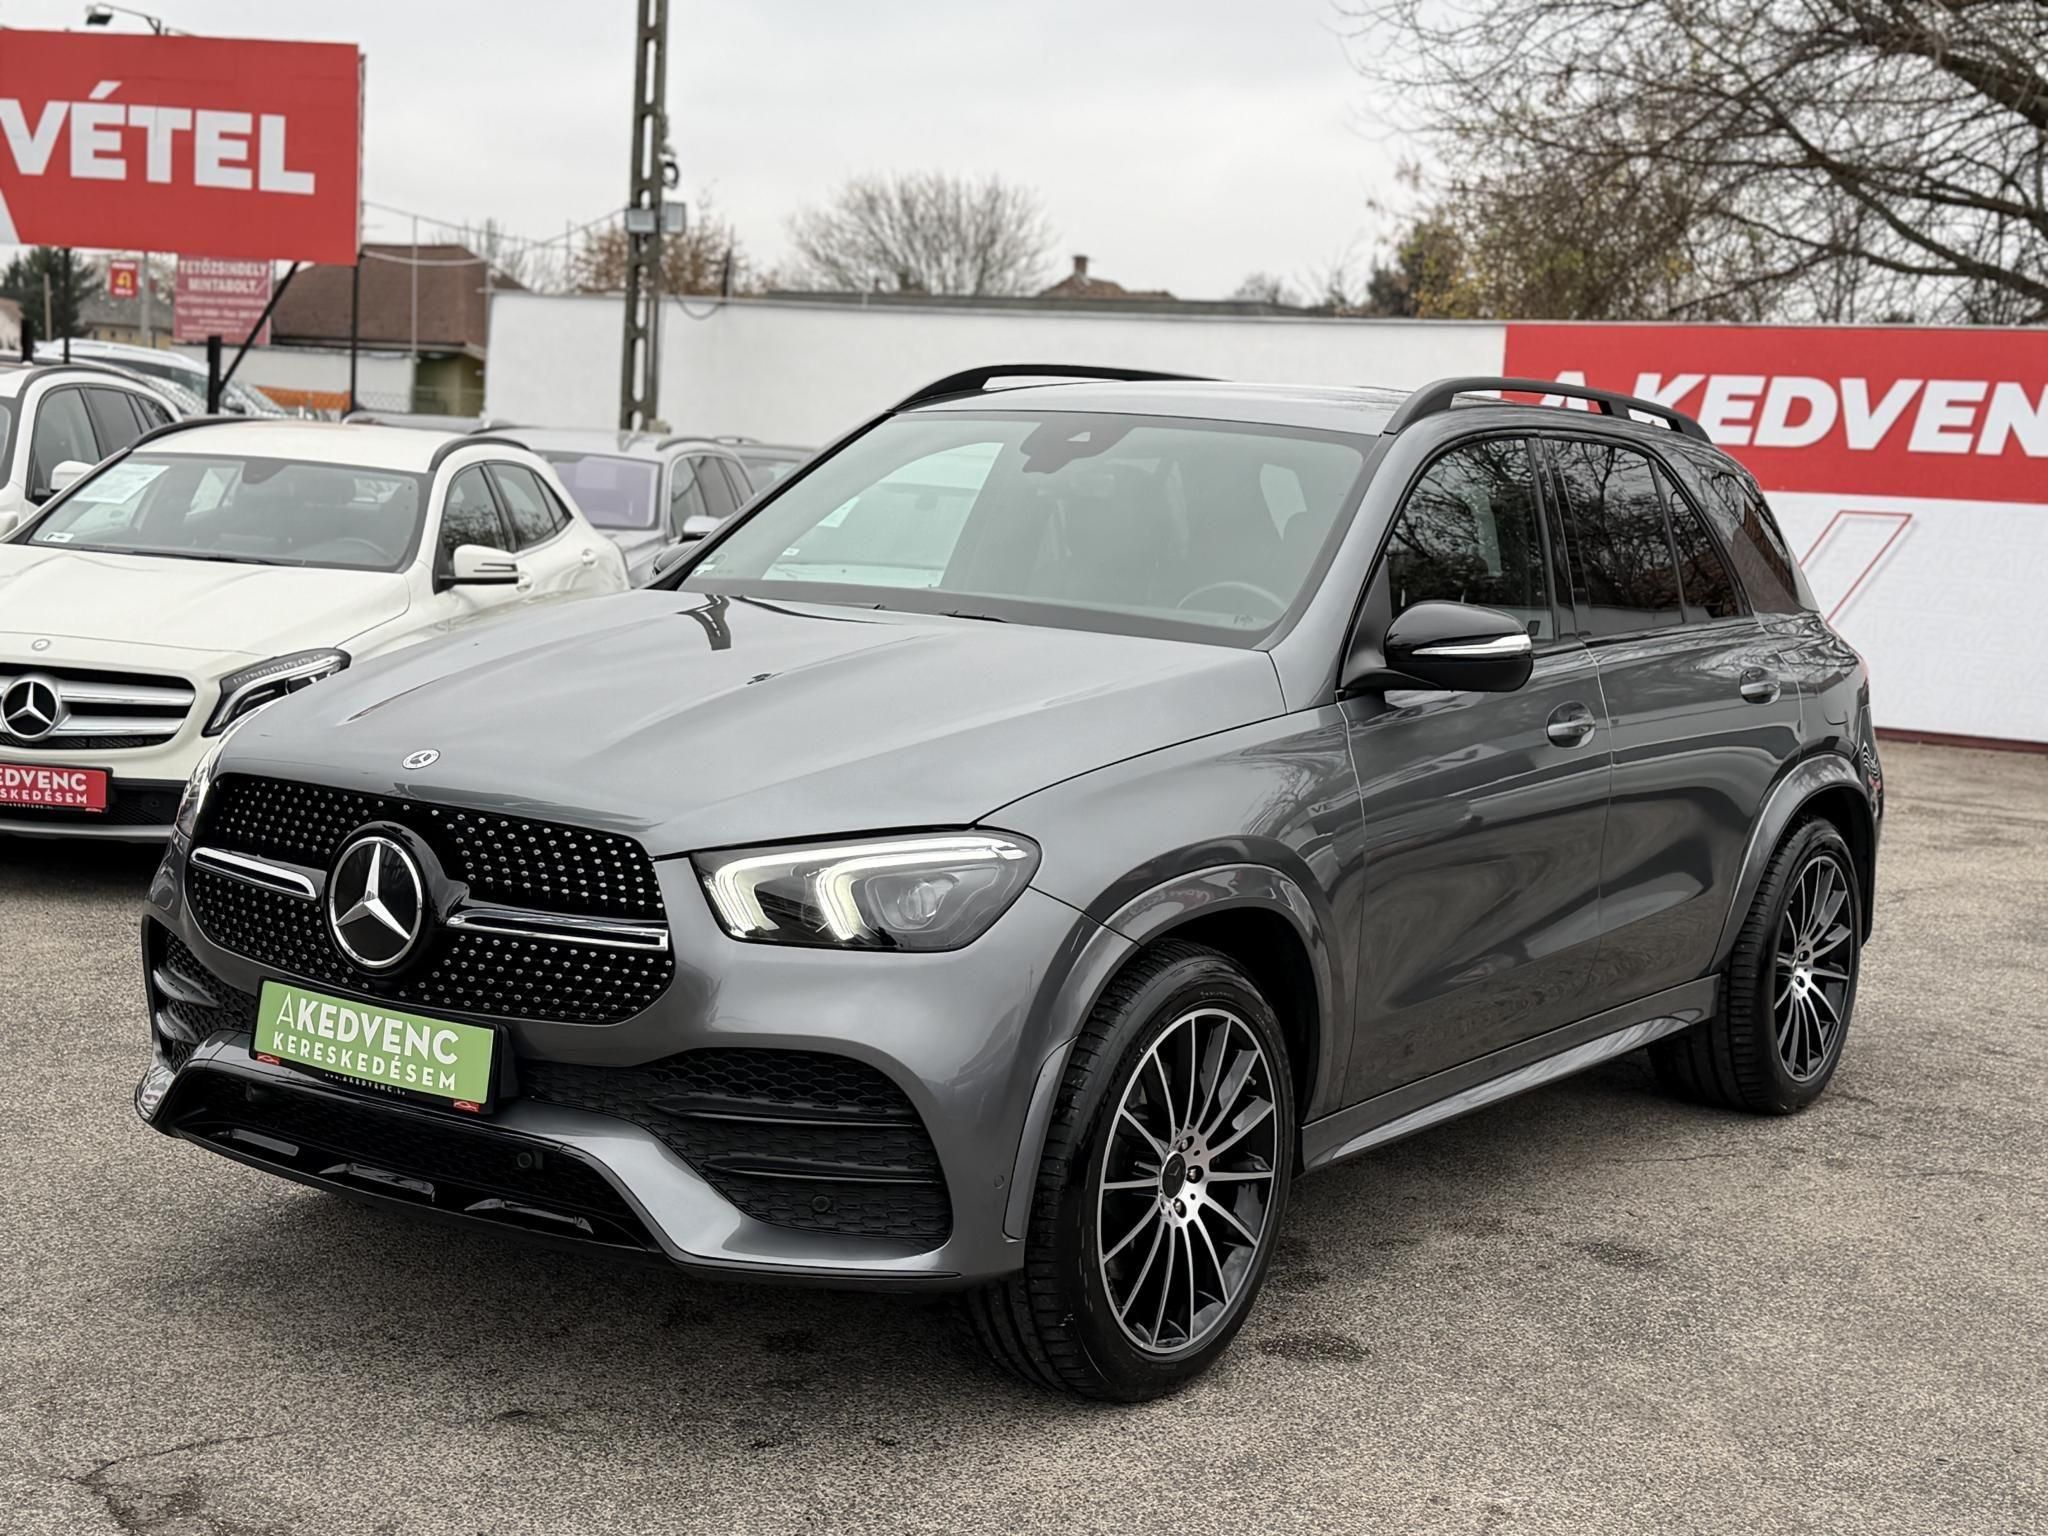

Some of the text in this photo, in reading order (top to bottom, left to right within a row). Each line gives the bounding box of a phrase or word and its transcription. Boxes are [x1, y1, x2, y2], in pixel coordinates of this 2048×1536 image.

[0, 81, 316, 195] VÉTEL
[0, 768, 87, 792] DVENC
[273, 1031, 456, 1091] KERESKEDÉSEM
